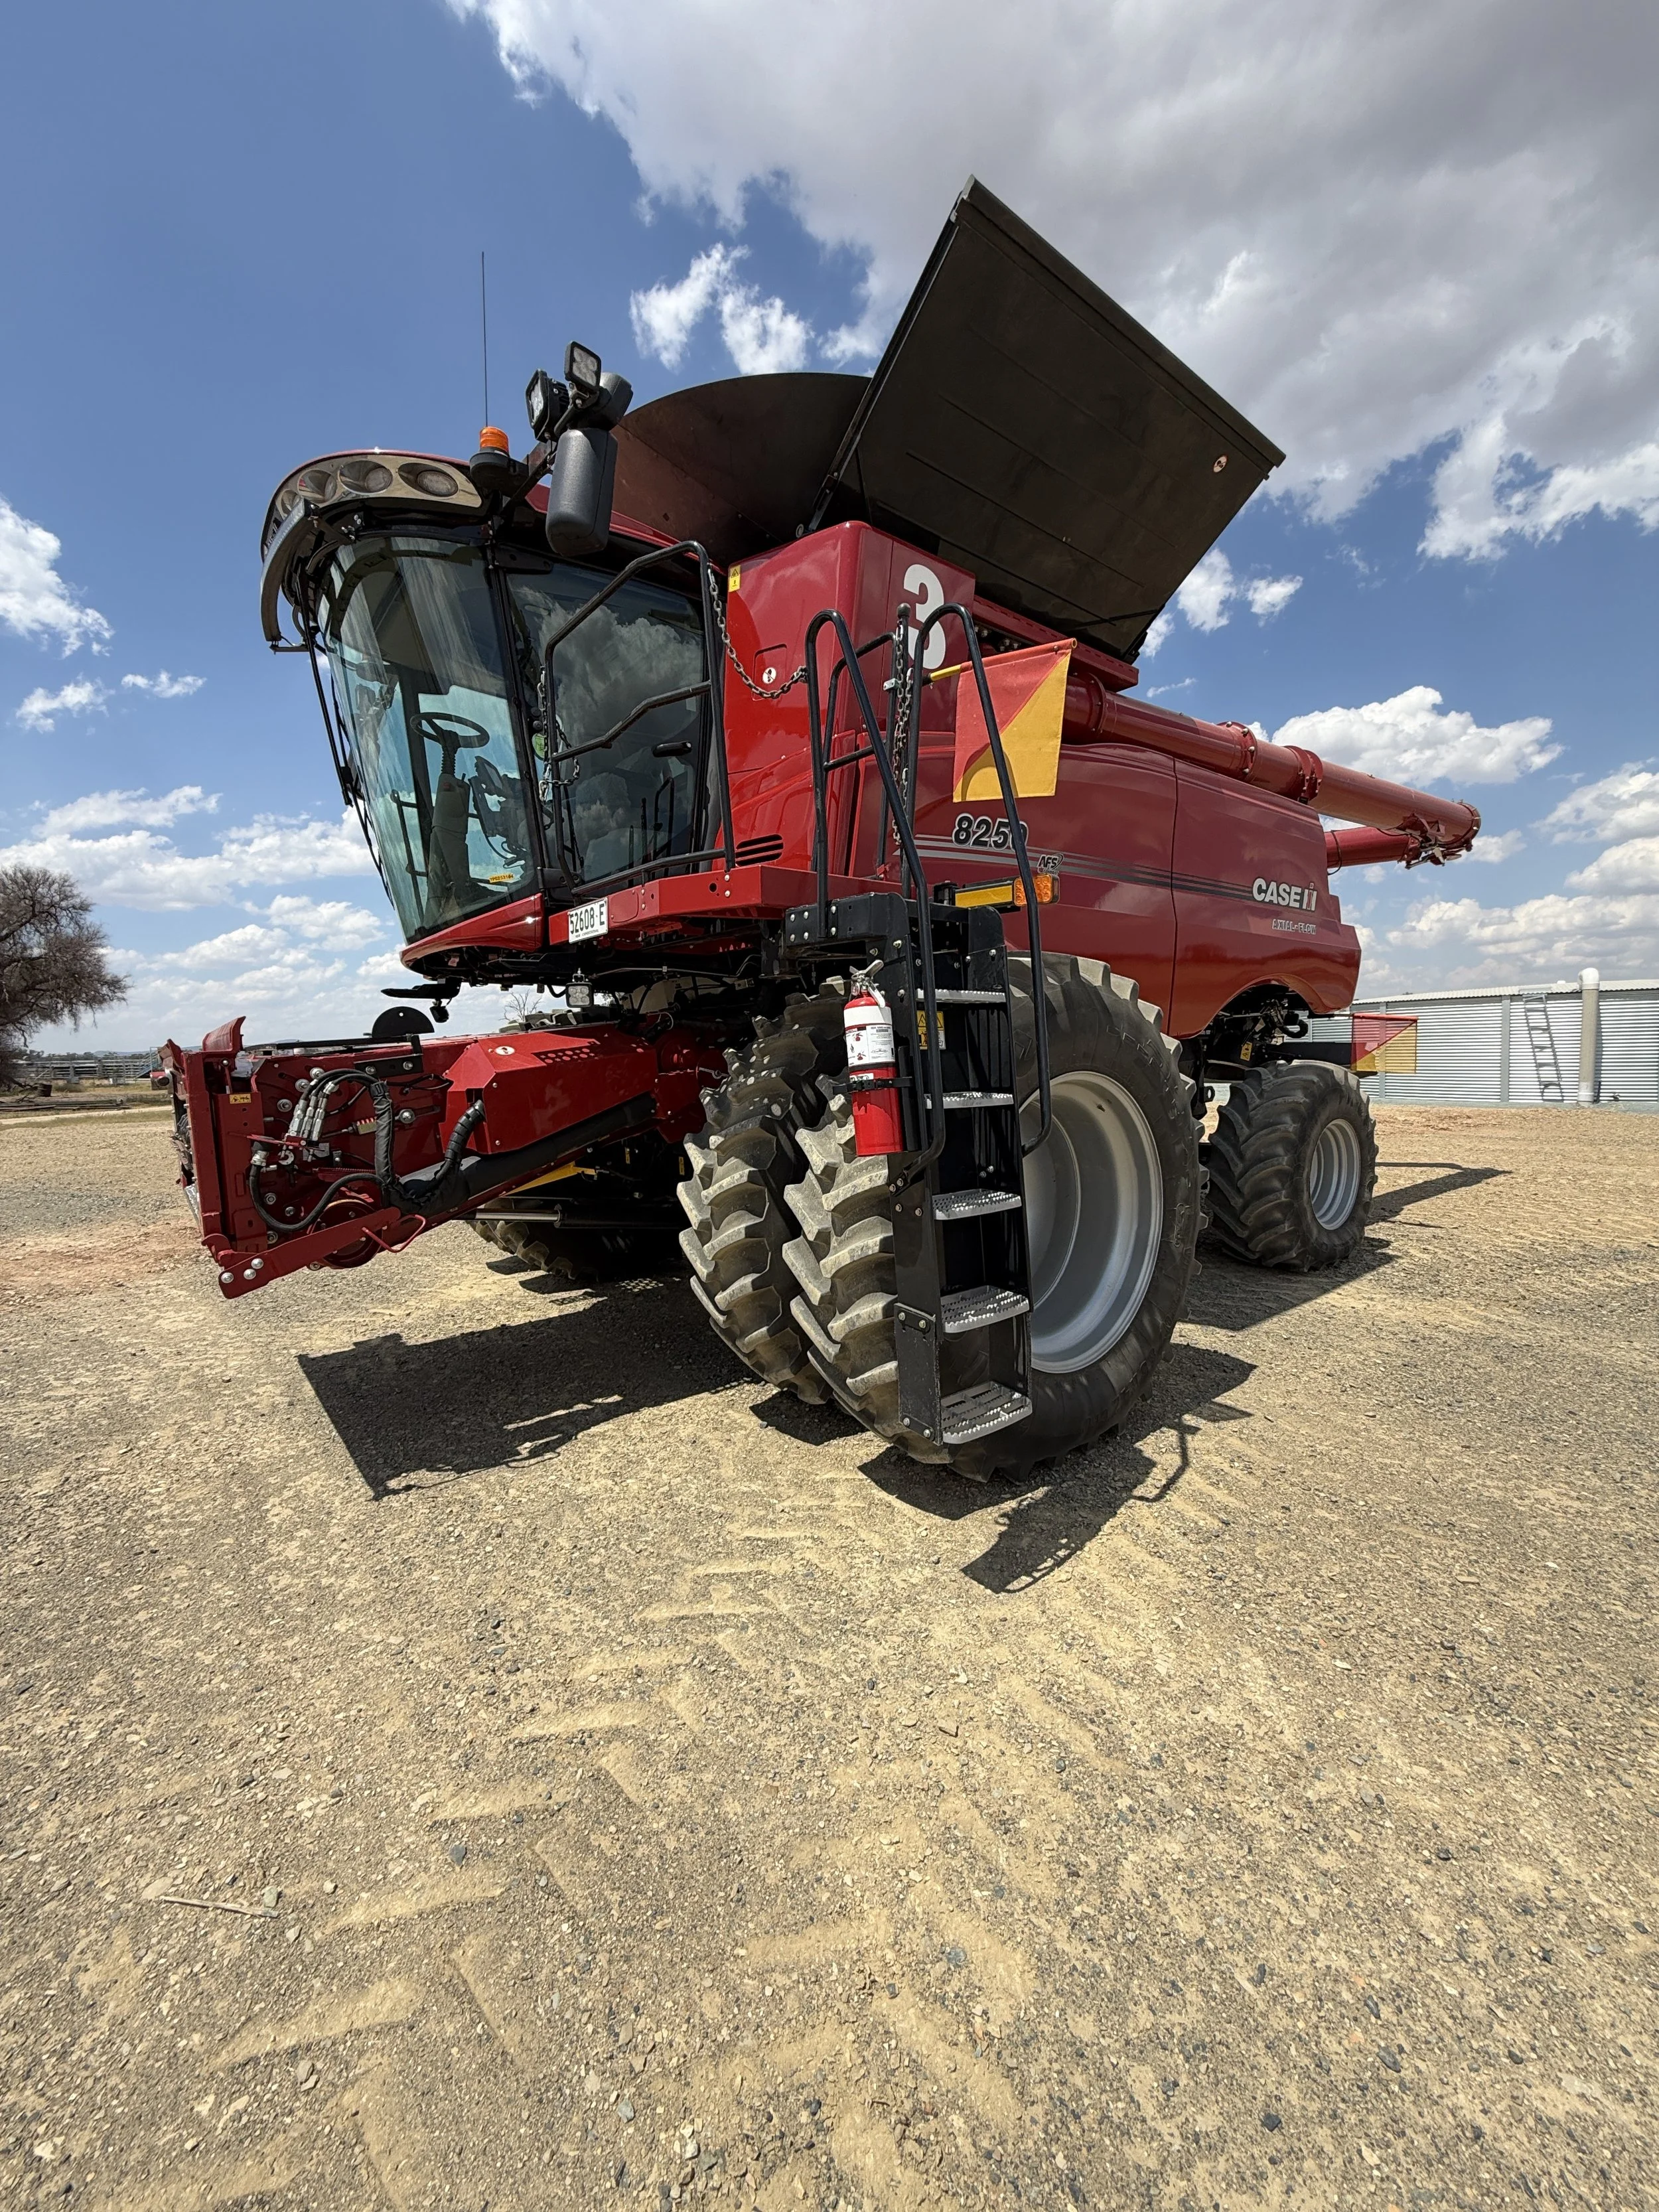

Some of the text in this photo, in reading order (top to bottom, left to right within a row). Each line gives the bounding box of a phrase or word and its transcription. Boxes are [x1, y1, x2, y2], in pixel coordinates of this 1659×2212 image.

[904, 564, 946, 670] 3
[1037, 854, 1059, 869] AFS
[1253, 878, 1301, 908] CASE
[1272, 919, 1317, 934] AXIAL-FLOW
